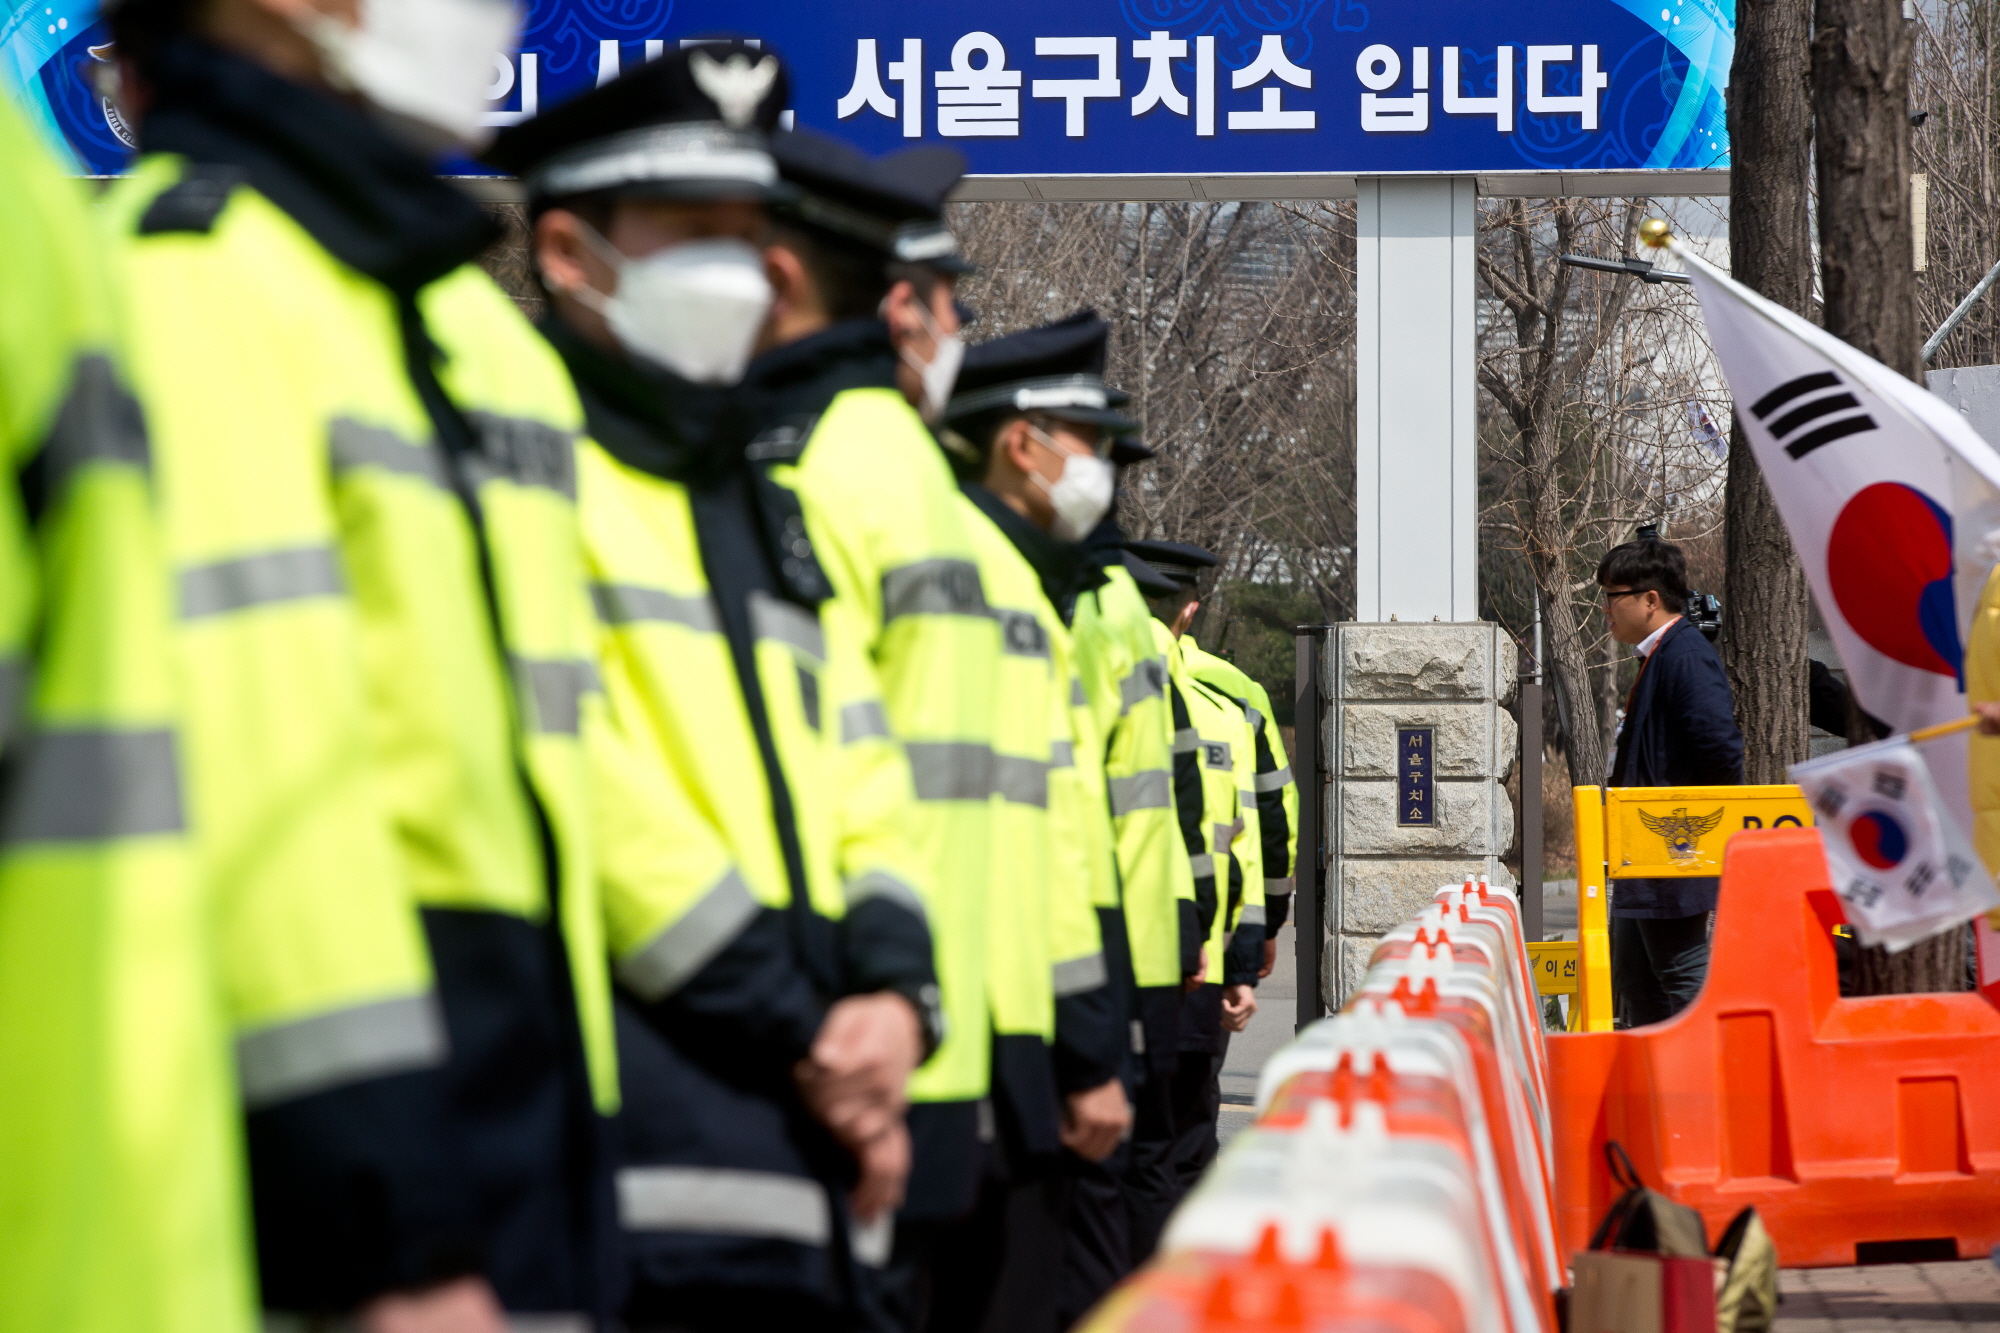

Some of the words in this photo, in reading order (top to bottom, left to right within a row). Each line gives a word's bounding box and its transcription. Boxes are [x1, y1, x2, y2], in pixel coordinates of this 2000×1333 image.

[837, 31, 1316, 138] 서울구치소
[1355, 44, 1608, 132] 입니다
[1408, 735, 1424, 820] 서울구치소
[1545, 959, 1558, 978] 이
